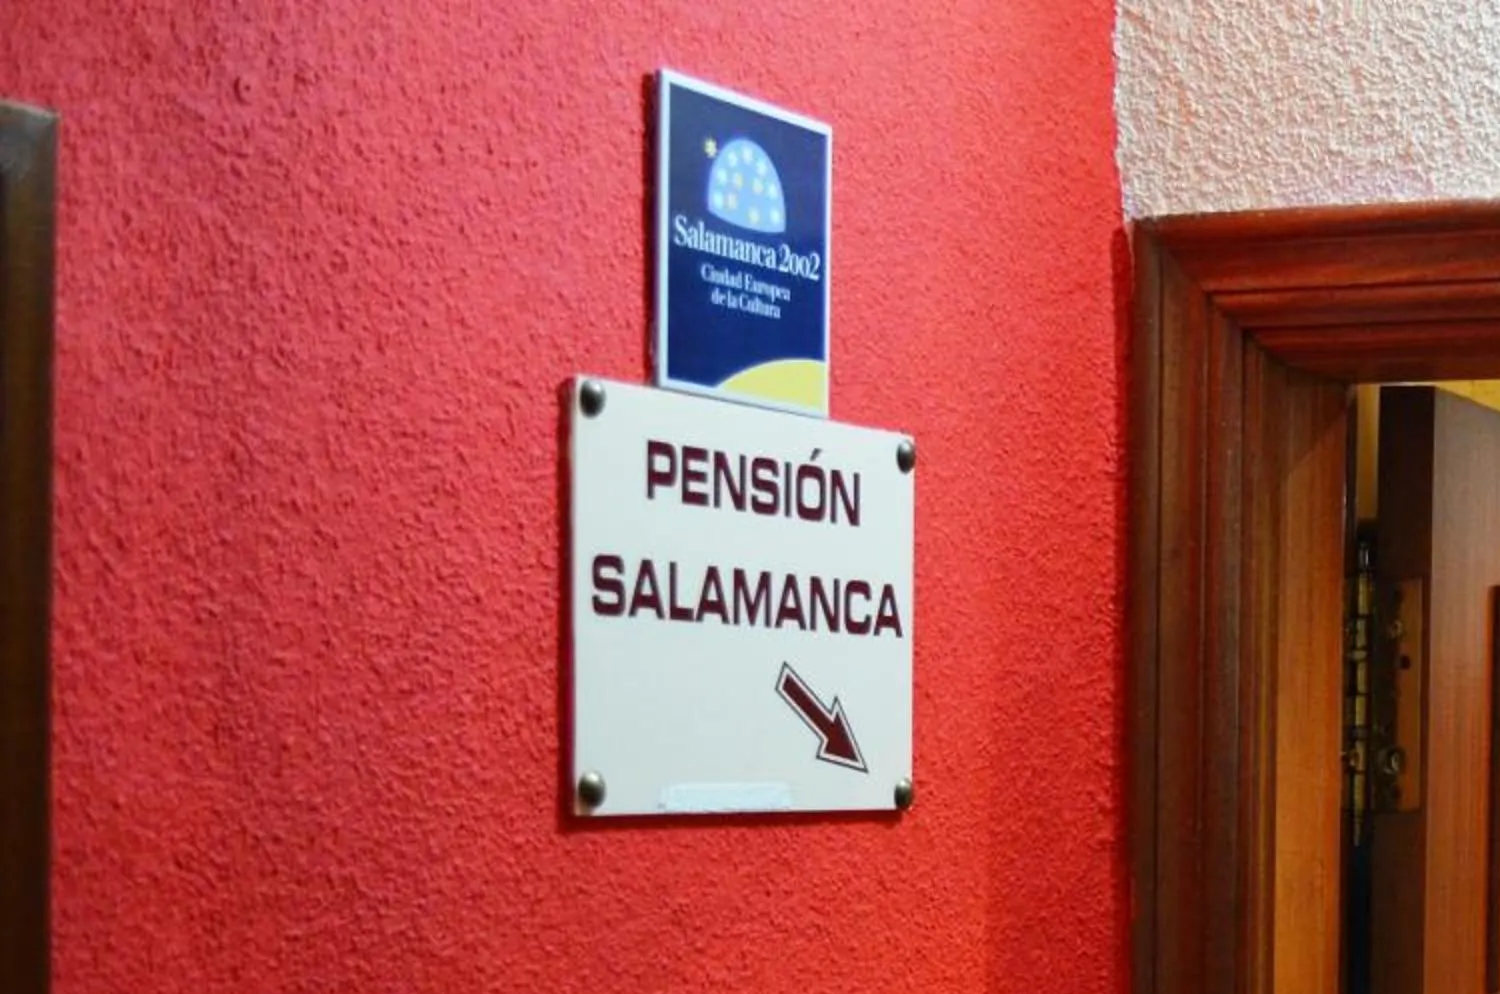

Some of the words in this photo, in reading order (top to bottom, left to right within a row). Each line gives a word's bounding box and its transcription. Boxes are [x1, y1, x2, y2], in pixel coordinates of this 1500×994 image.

[674, 214, 776, 269] Salamanca
[779, 243, 821, 281] 2002
[700, 263, 743, 289] Ciudad
[744, 274, 791, 302] Europea
[711, 288, 725, 305] de
[727, 290, 738, 309] la
[739, 293, 781, 319] Cultura
[646, 438, 861, 527] PENSIÓN
[591, 553, 903, 638] SALAMANCA
